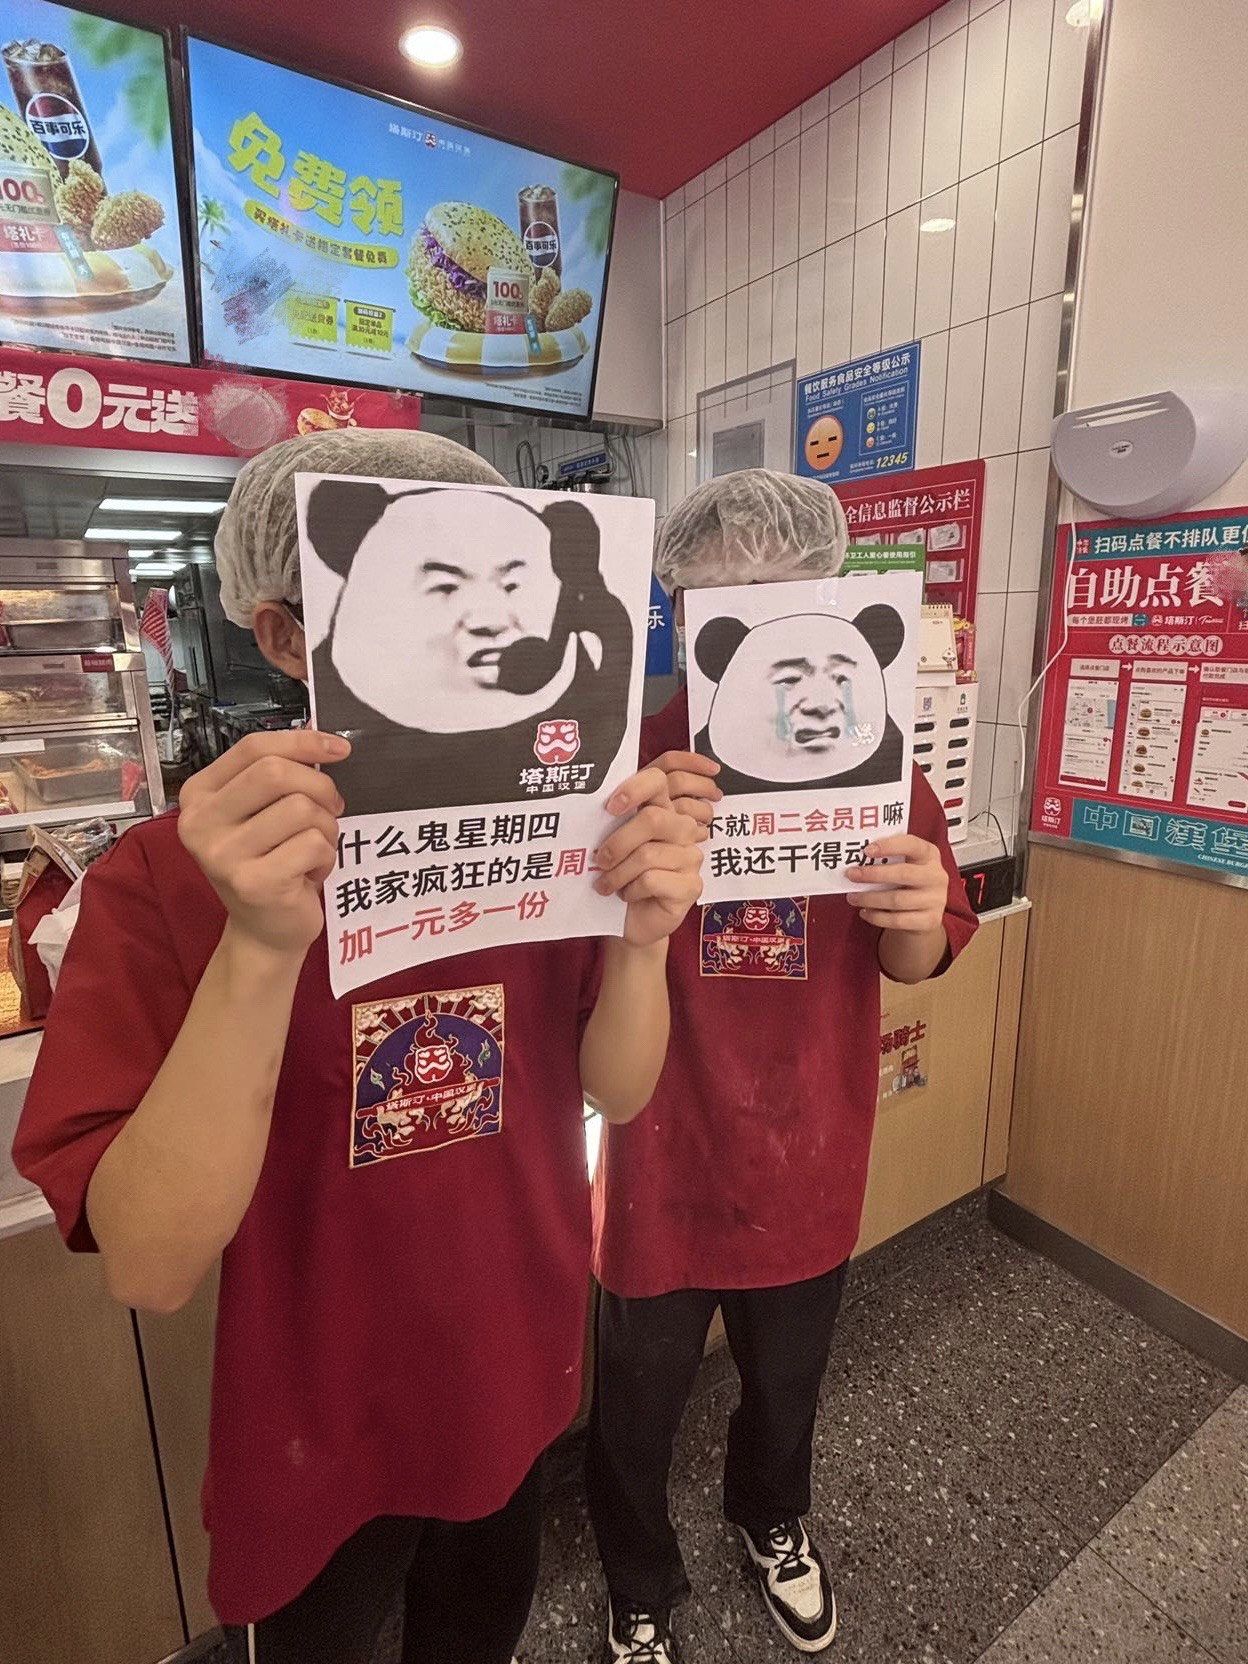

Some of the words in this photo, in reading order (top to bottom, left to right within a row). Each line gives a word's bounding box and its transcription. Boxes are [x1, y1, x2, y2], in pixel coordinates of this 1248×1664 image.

[30, 119, 86, 135] 百事可乐
[227, 111, 404, 236] 免费领
[526, 239, 557, 251] 百事可乐
[876, 451, 909, 469] 12345
[1111, 637, 1220, 654] 点餐流程示意图
[519, 763, 595, 785] 塔斯汀
[525, 780, 586, 794] 中国汉堡
[337, 812, 561, 869] 什么鬼星期四
[335, 847, 603, 919] 我家疯狂的是周
[338, 890, 550, 966] 加一元多一份
